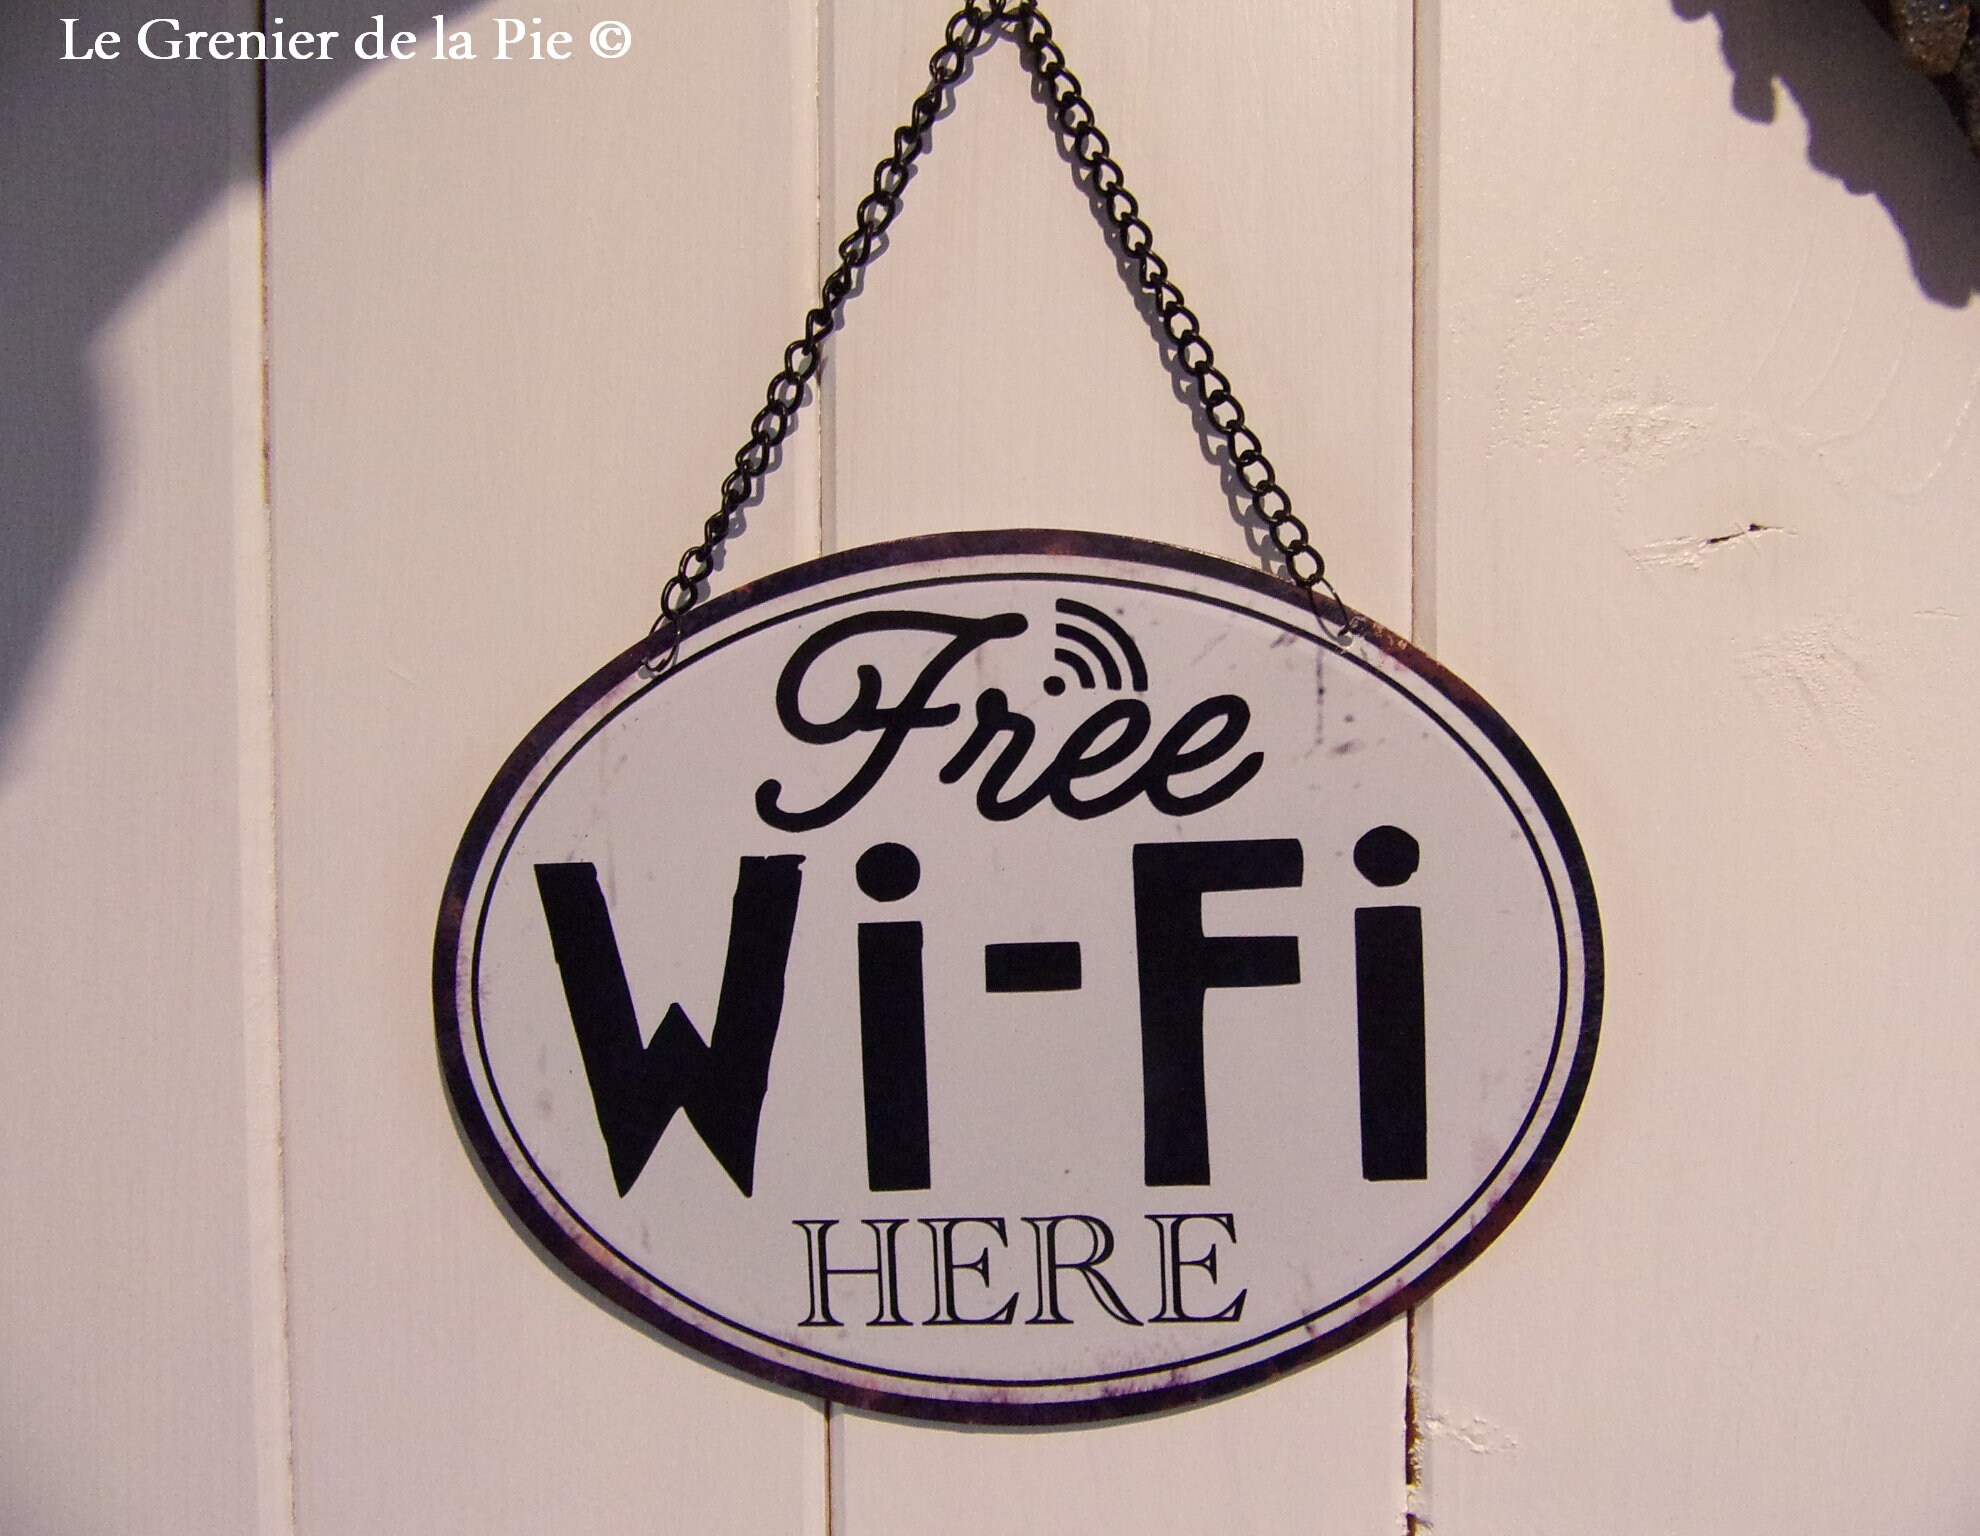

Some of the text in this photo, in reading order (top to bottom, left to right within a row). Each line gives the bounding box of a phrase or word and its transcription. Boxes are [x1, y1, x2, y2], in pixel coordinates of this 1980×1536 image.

[755, 609, 1265, 833] Free
[533, 825, 1428, 1199] Wi-Fi
[791, 1213, 1248, 1327] HERE
